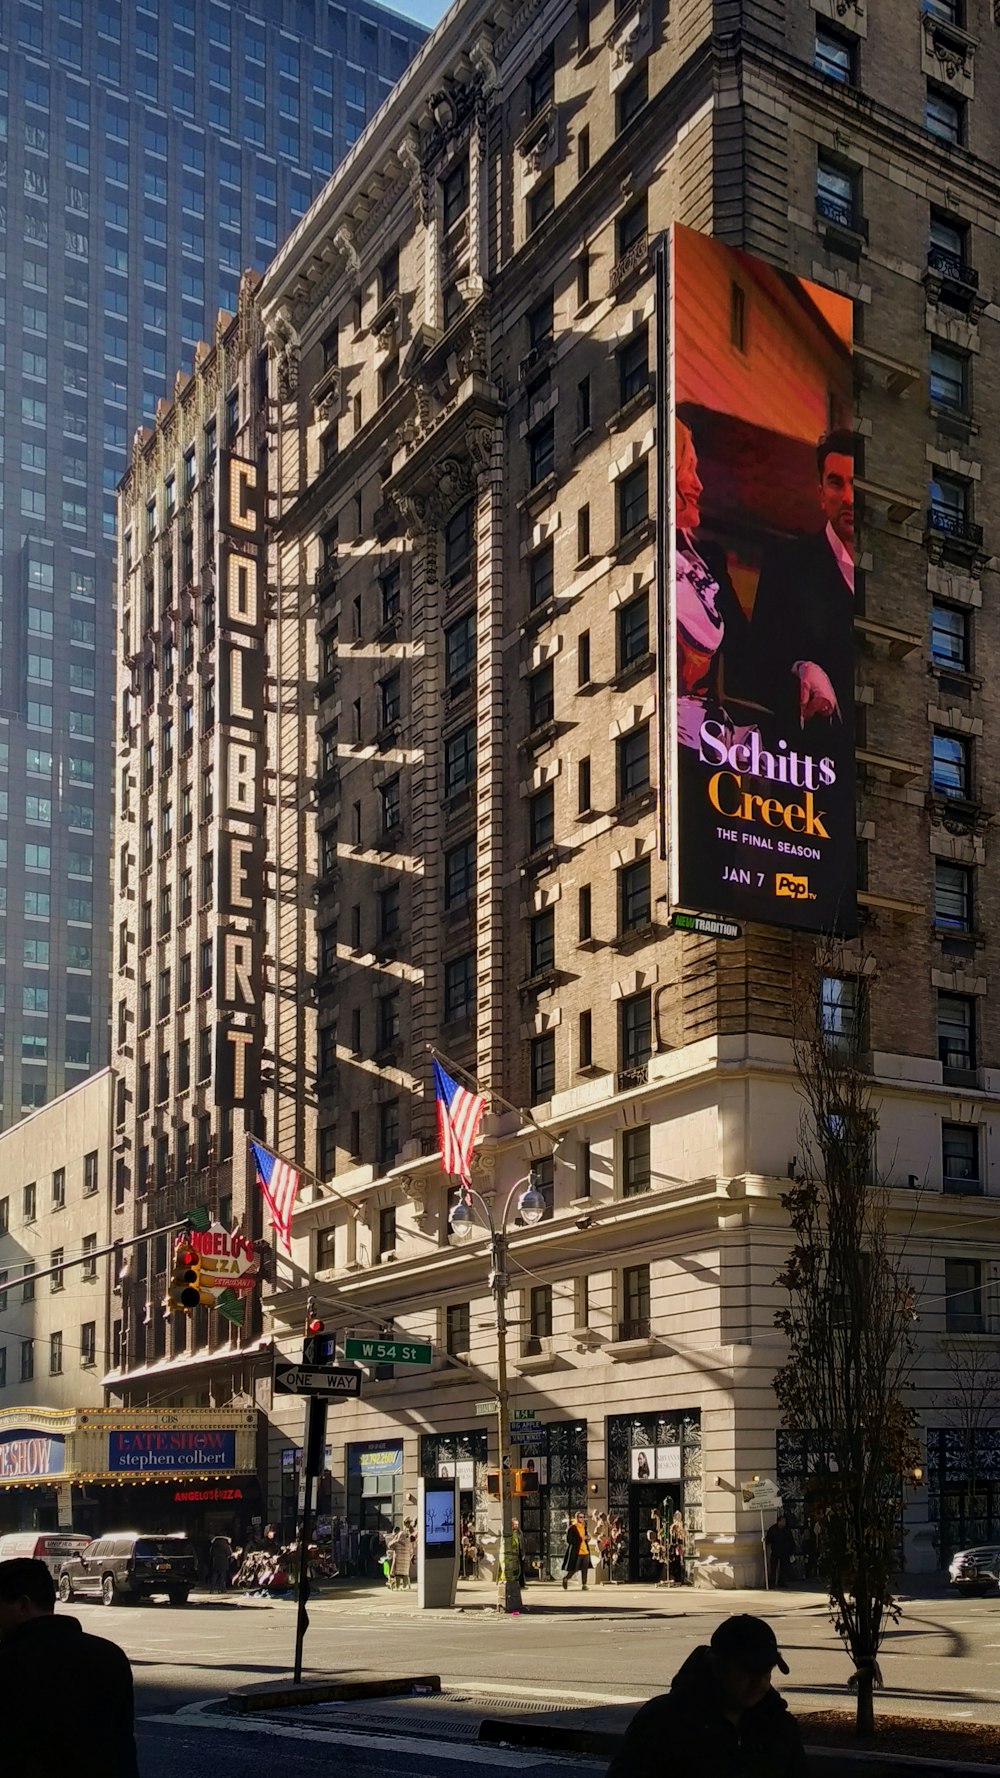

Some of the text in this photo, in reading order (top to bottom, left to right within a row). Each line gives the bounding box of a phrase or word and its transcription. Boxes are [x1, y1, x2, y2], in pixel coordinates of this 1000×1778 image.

[226, 457, 257, 1100] COLBERT
[708, 771, 832, 840] Creek
[717, 828, 821, 860] THE FINAL SEASON
[722, 866, 751, 885] JAN
[756, 872, 765, 887] 7
[778, 877, 806, 898] Pop
[176, 1229, 254, 1262] NGELO'S
[362, 1343, 417, 1360] W 54 St
[286, 1373, 354, 1388] ONE WAY
[161, 1415, 179, 1423] CBS
[521, 1410, 528, 1419] 54
[117, 1432, 226, 1450] LATE SHOW
[10, 1438, 52, 1476] SHOW
[119, 1450, 226, 1470] stephen colbert
